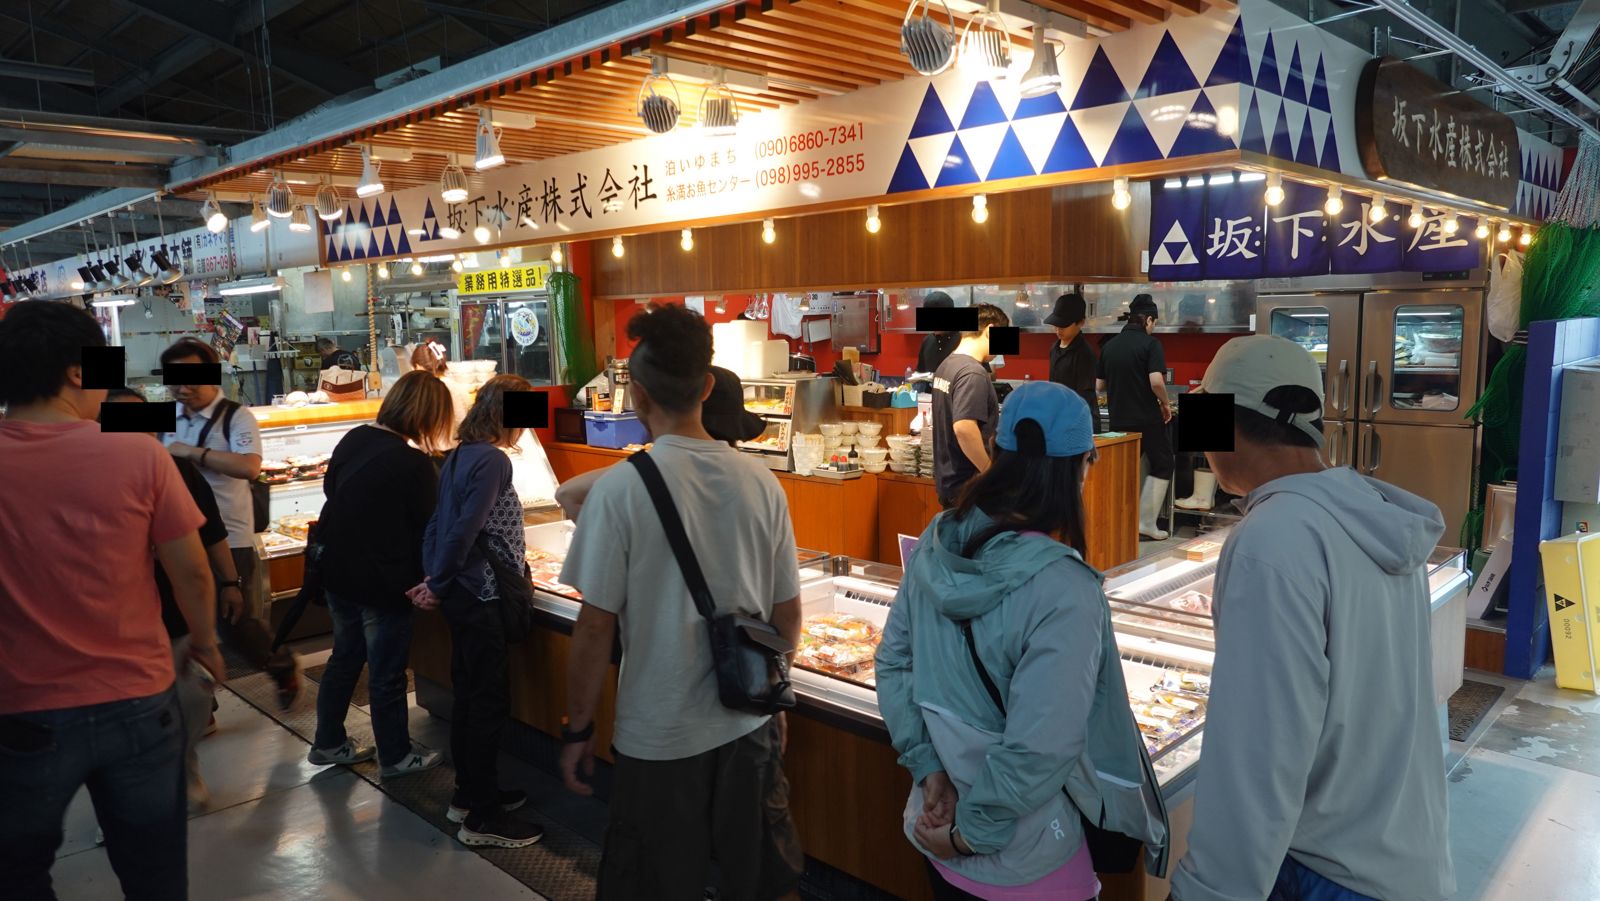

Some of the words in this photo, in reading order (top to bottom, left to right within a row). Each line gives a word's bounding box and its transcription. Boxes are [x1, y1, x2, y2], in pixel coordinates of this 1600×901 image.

[665, 147, 737, 177] 泊いゆまち
[754, 121, 865, 159] (090)6860-7341
[1392, 96, 1510, 180] 坂下水産株式会社
[666, 176, 751, 202] 糸満お魚センター
[755, 153, 865, 189] (098)995-2855
[464, 267, 542, 292] 業務用特選品!
